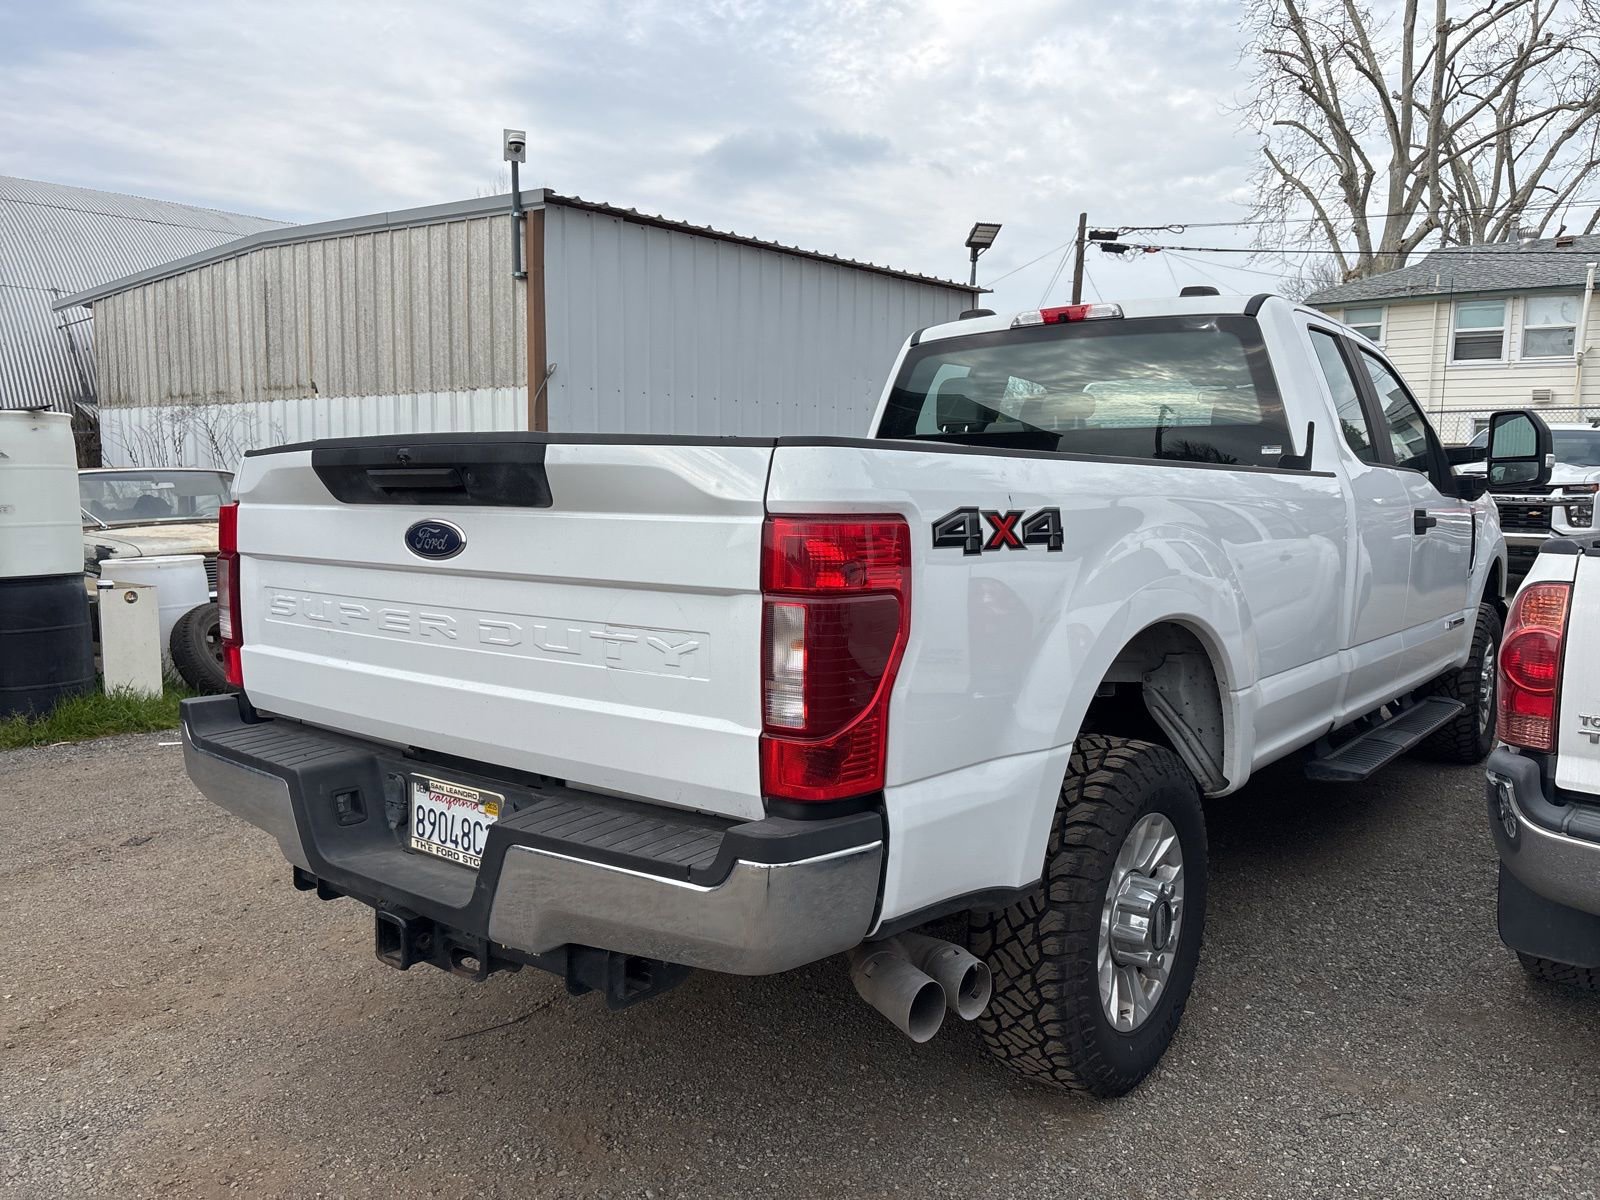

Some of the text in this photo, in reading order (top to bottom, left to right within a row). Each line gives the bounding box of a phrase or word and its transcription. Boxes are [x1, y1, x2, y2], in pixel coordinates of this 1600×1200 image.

[415, 527, 449, 550] Ford
[271, 595, 699, 668] SUPER DUTY
[430, 782, 445, 791] SAN
[445, 787, 478, 800] LEANDRO
[415, 839, 433, 852] THE
[436, 844, 460, 860] FORD
